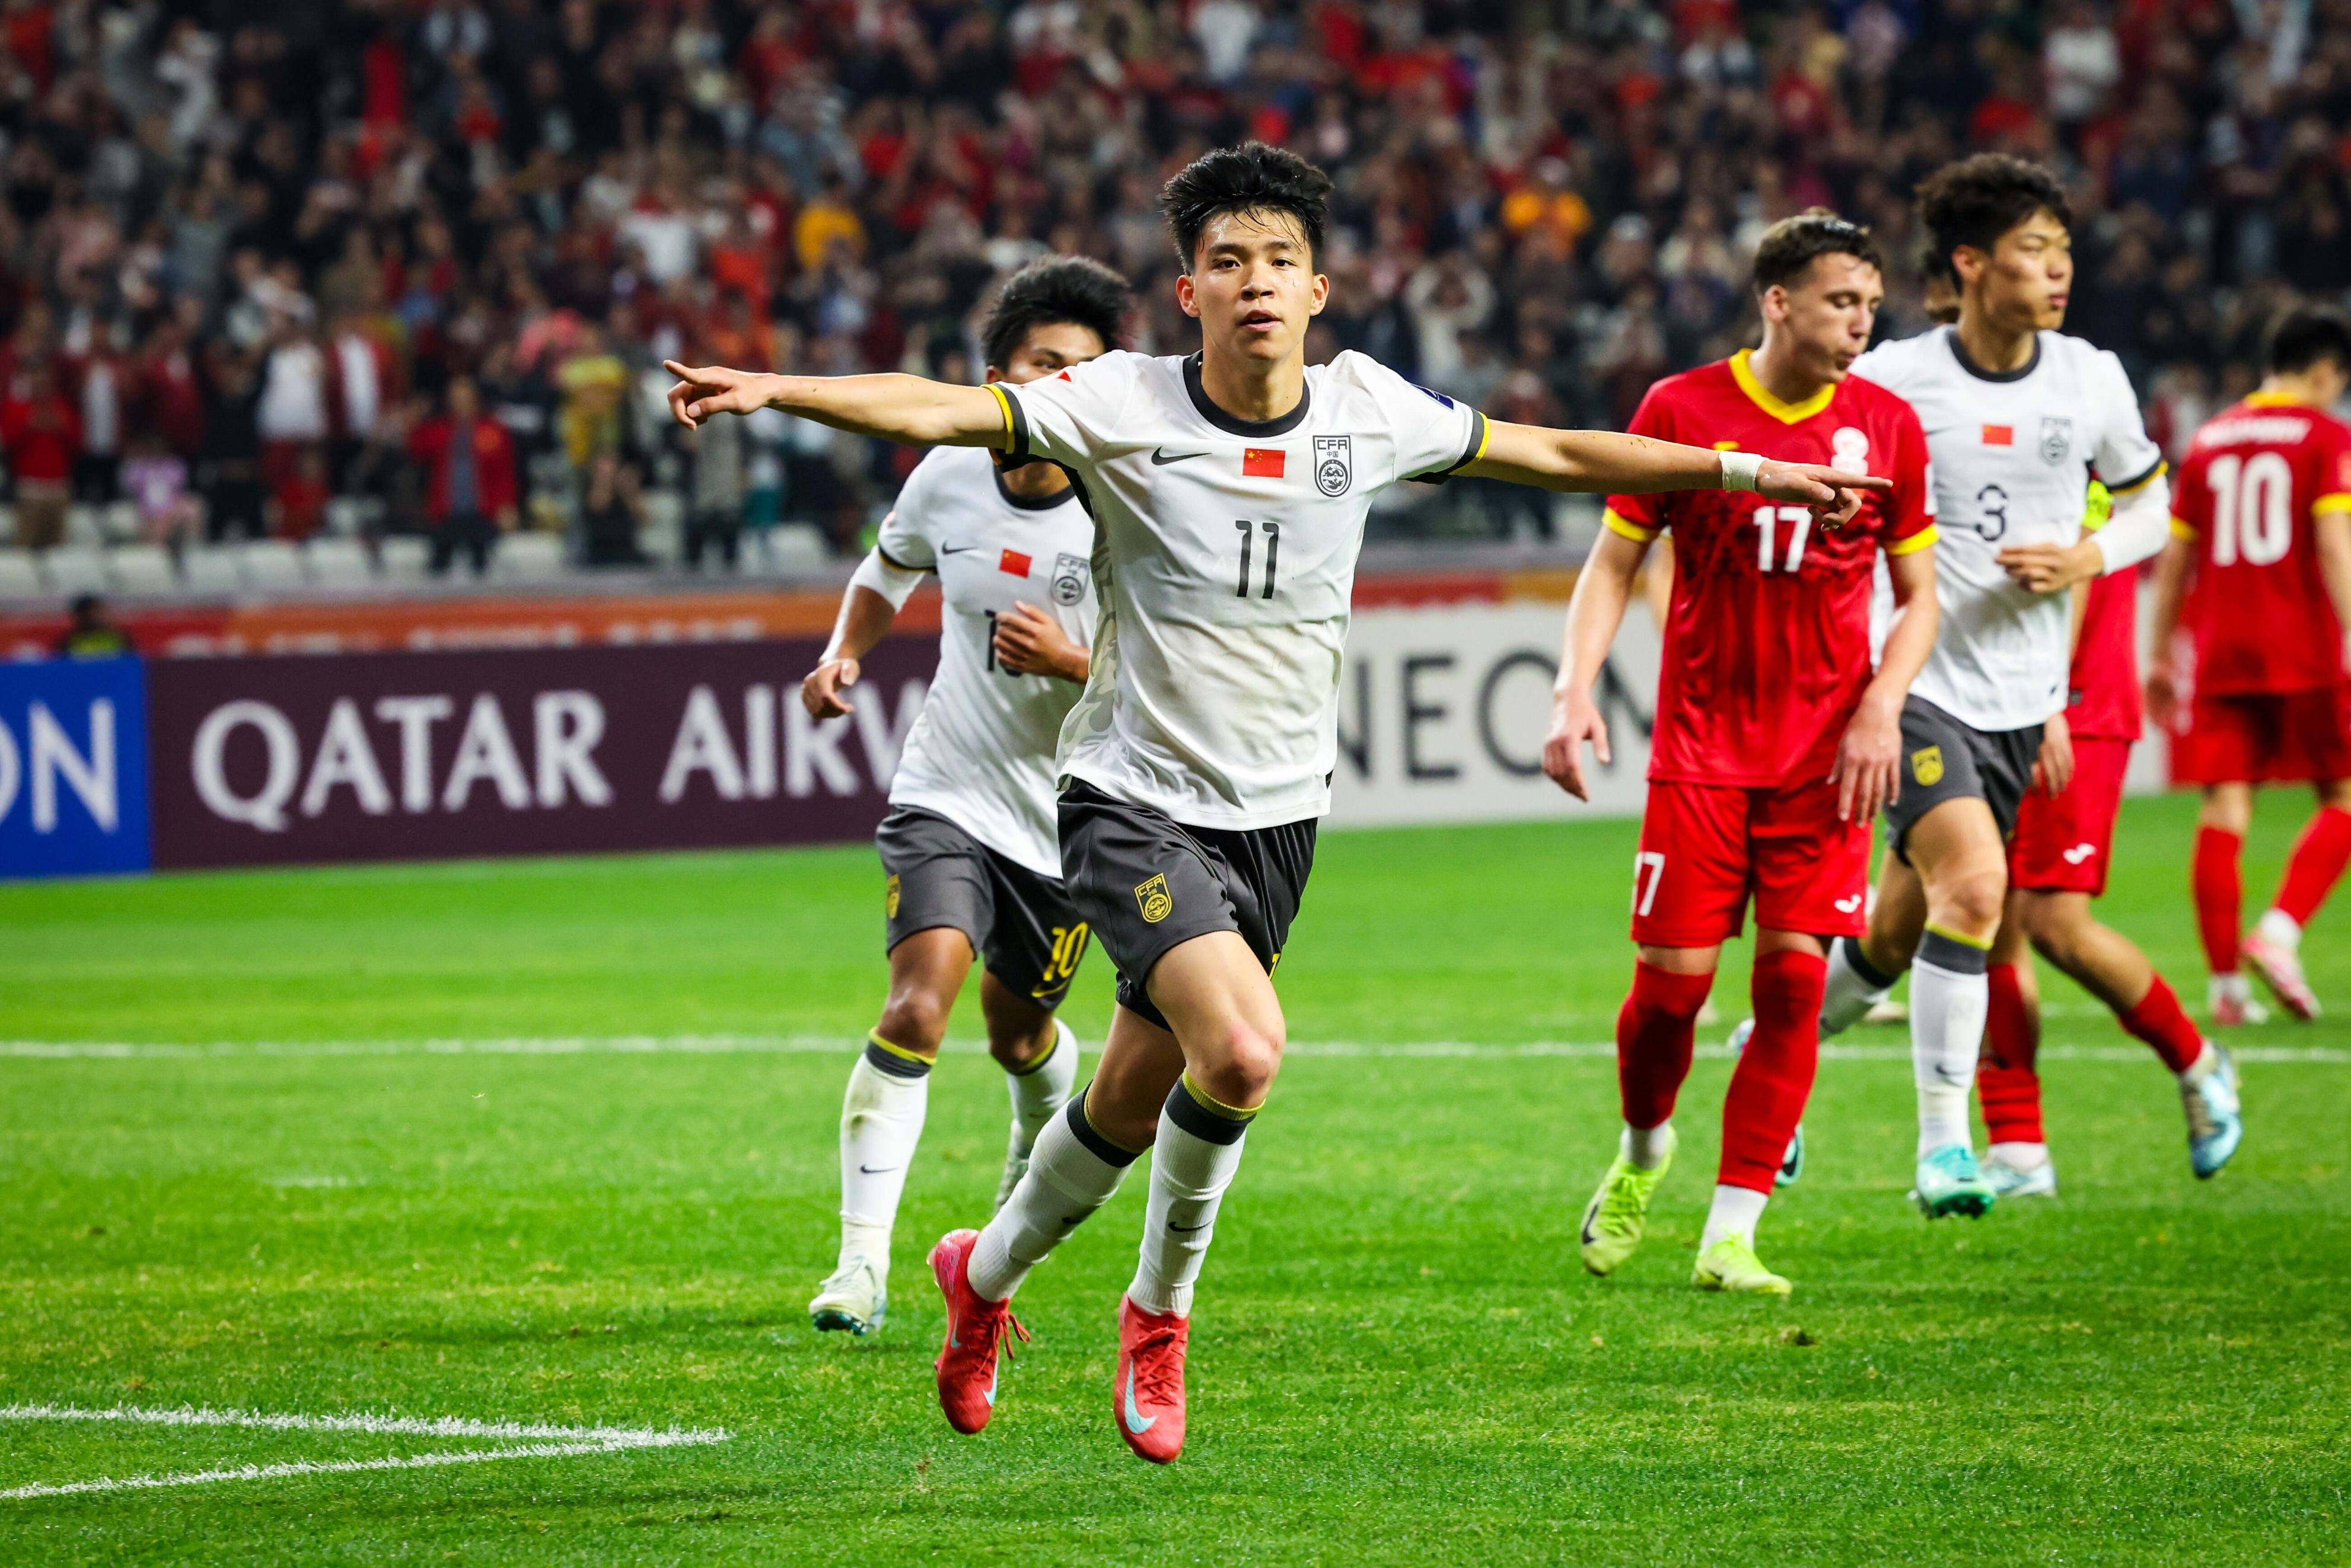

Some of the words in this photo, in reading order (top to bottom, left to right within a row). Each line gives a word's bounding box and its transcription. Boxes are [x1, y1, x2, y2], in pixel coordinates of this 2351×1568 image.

[1317, 439, 1347, 450] CFA
[1753, 506, 1813, 572] 17
[1976, 484, 2008, 541] 3
[2206, 451, 2292, 566] 10
[1235, 520, 1279, 599] 11
[0, 697, 119, 833] N
[192, 691, 613, 833] QATAR
[1138, 877, 1162, 897] CFA
[1043, 922, 1088, 981] 10
